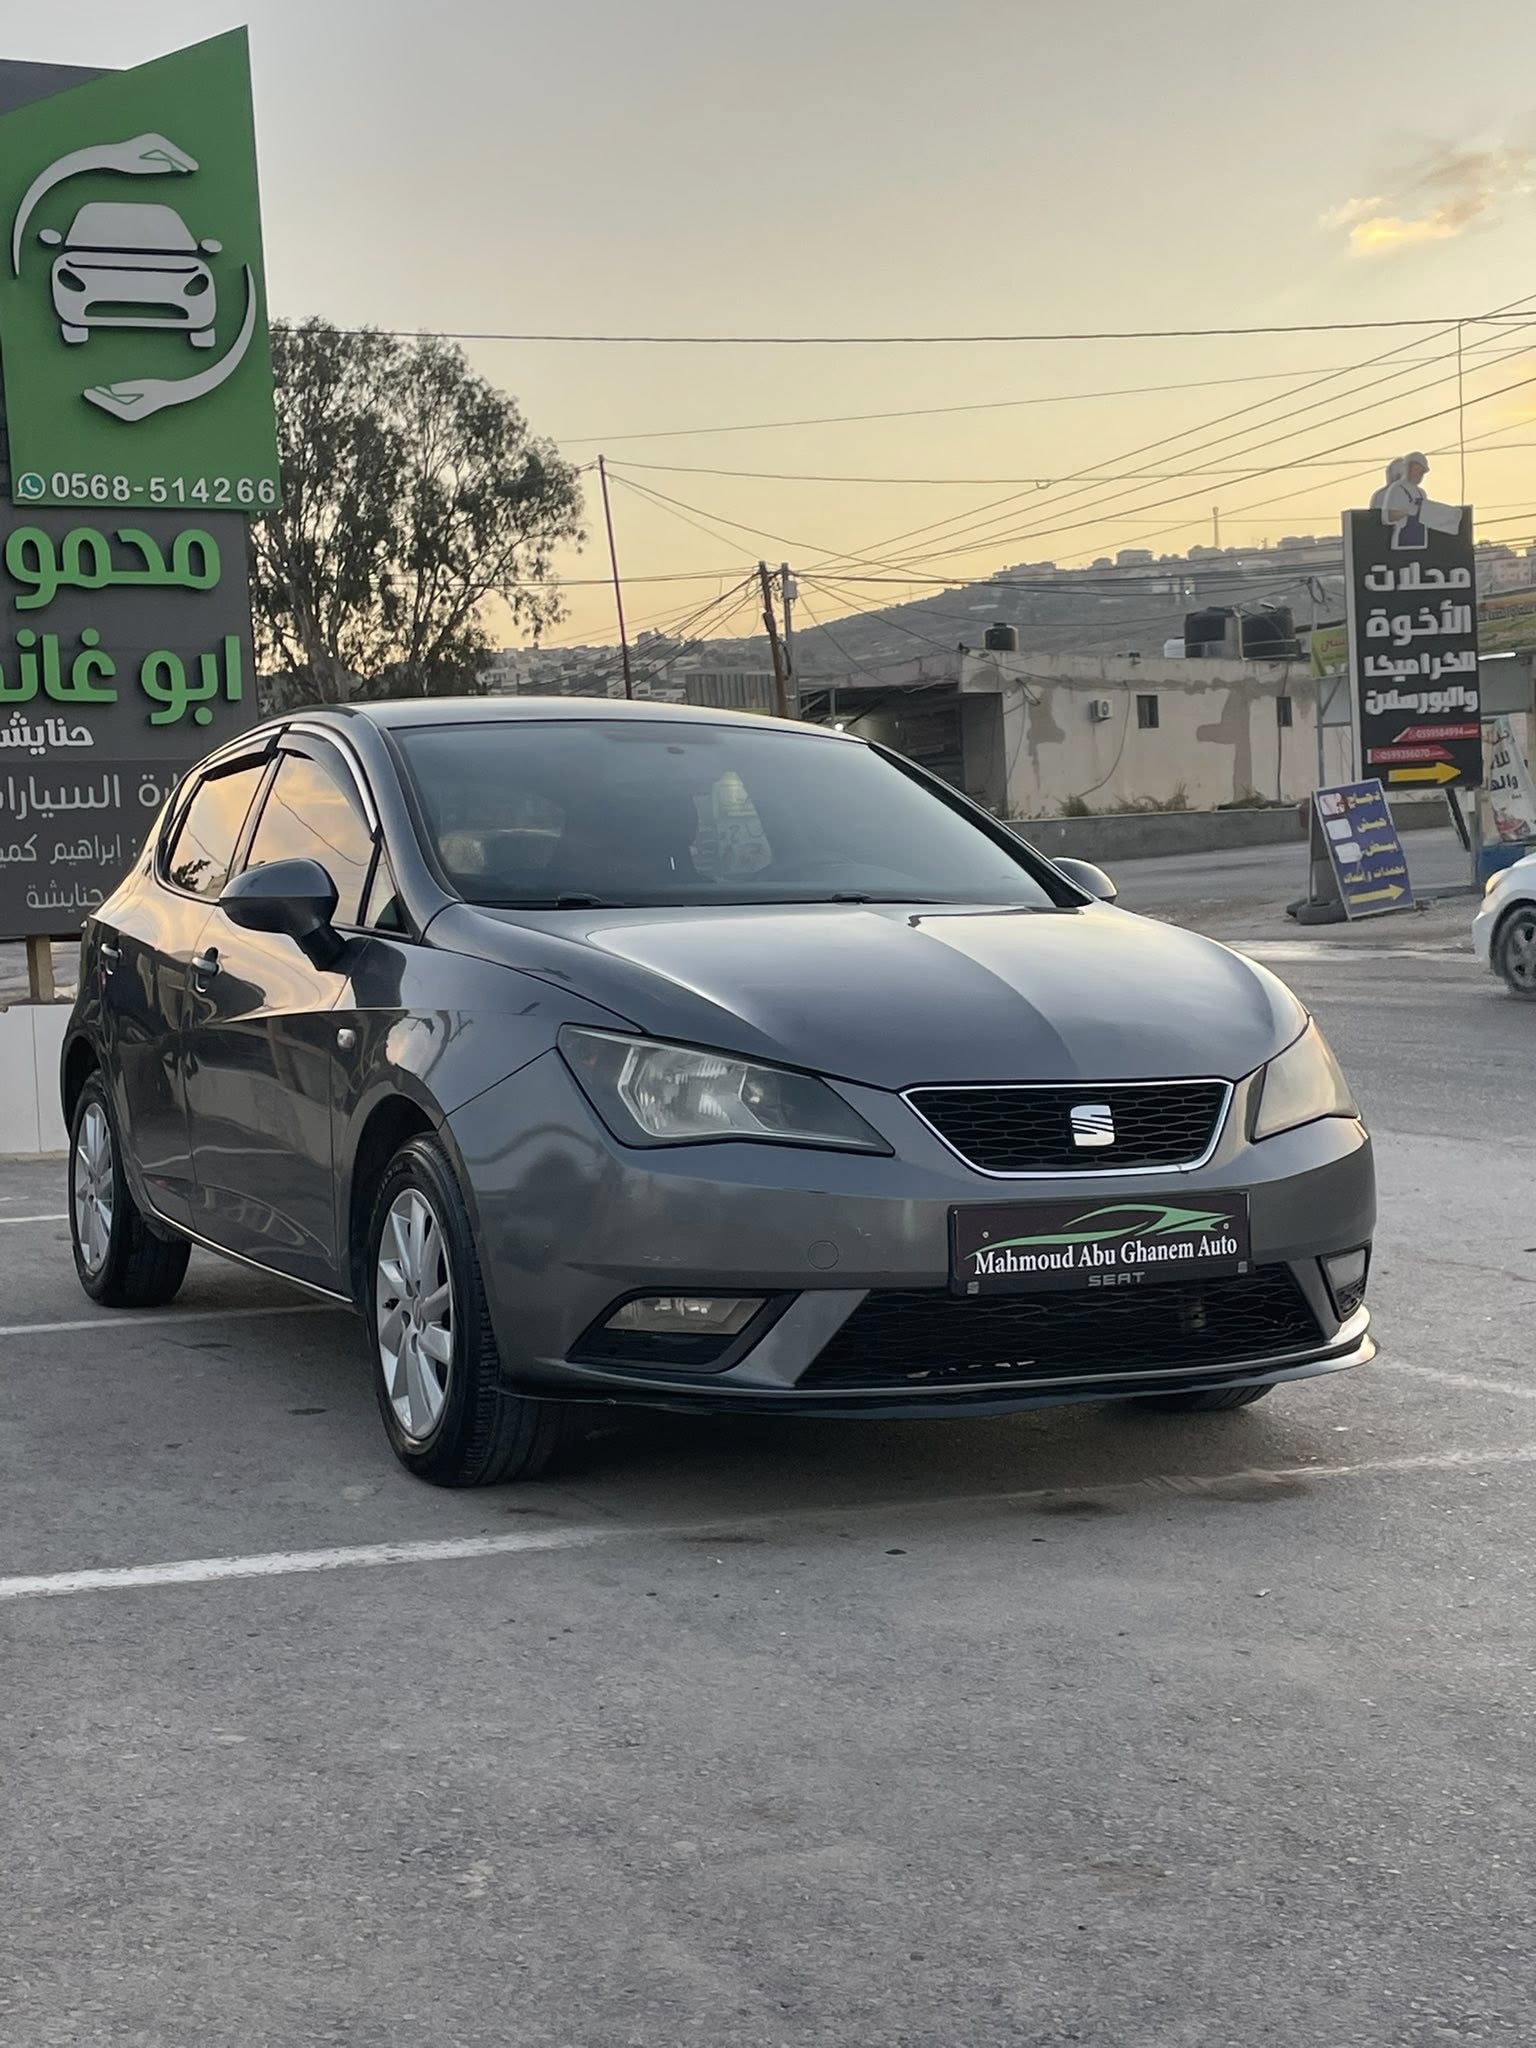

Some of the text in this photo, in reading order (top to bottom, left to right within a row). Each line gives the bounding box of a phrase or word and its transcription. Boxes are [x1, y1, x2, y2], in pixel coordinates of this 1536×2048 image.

[52, 472, 276, 504] 0568-514266
[6, 526, 221, 610] محمو
[1364, 562, 1471, 592] محلات
[1366, 599, 1472, 646] الأخوة
[0, 628, 242, 725] ابو غان
[0, 711, 95, 756] حنايش
[0, 774, 121, 820] السيارا
[974, 1234, 1238, 1275] Mahmoud Abu Ghanem Auto
[1088, 1271, 1146, 1287] SEAT
